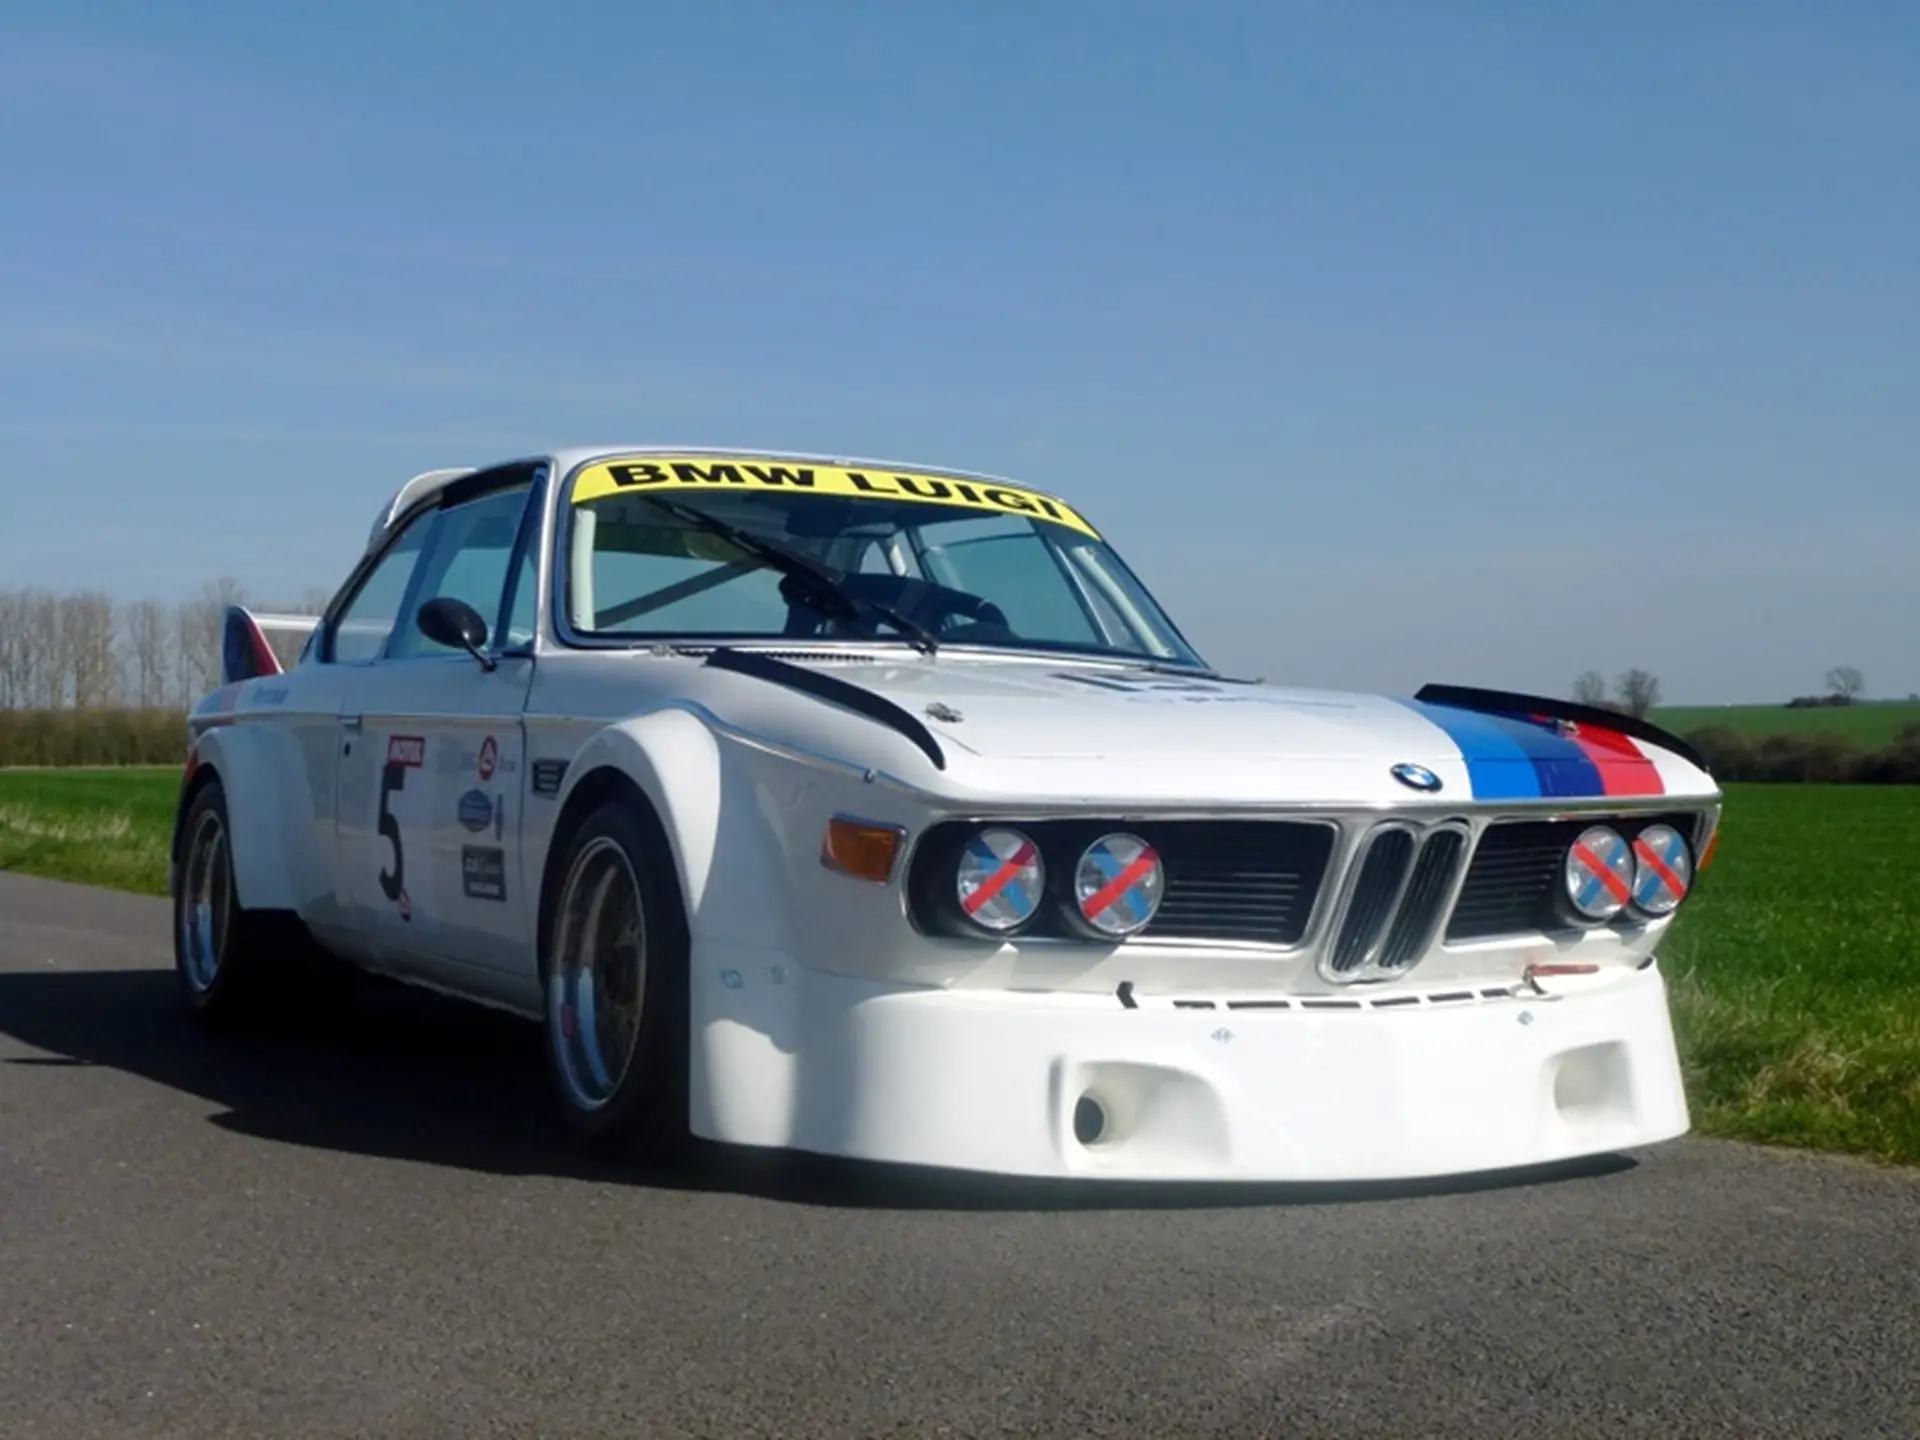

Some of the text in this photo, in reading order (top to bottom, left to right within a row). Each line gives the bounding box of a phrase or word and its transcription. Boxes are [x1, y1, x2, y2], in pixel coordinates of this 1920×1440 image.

[607, 463, 1063, 519] BMW LUIGI
[378, 764, 404, 902] 5
